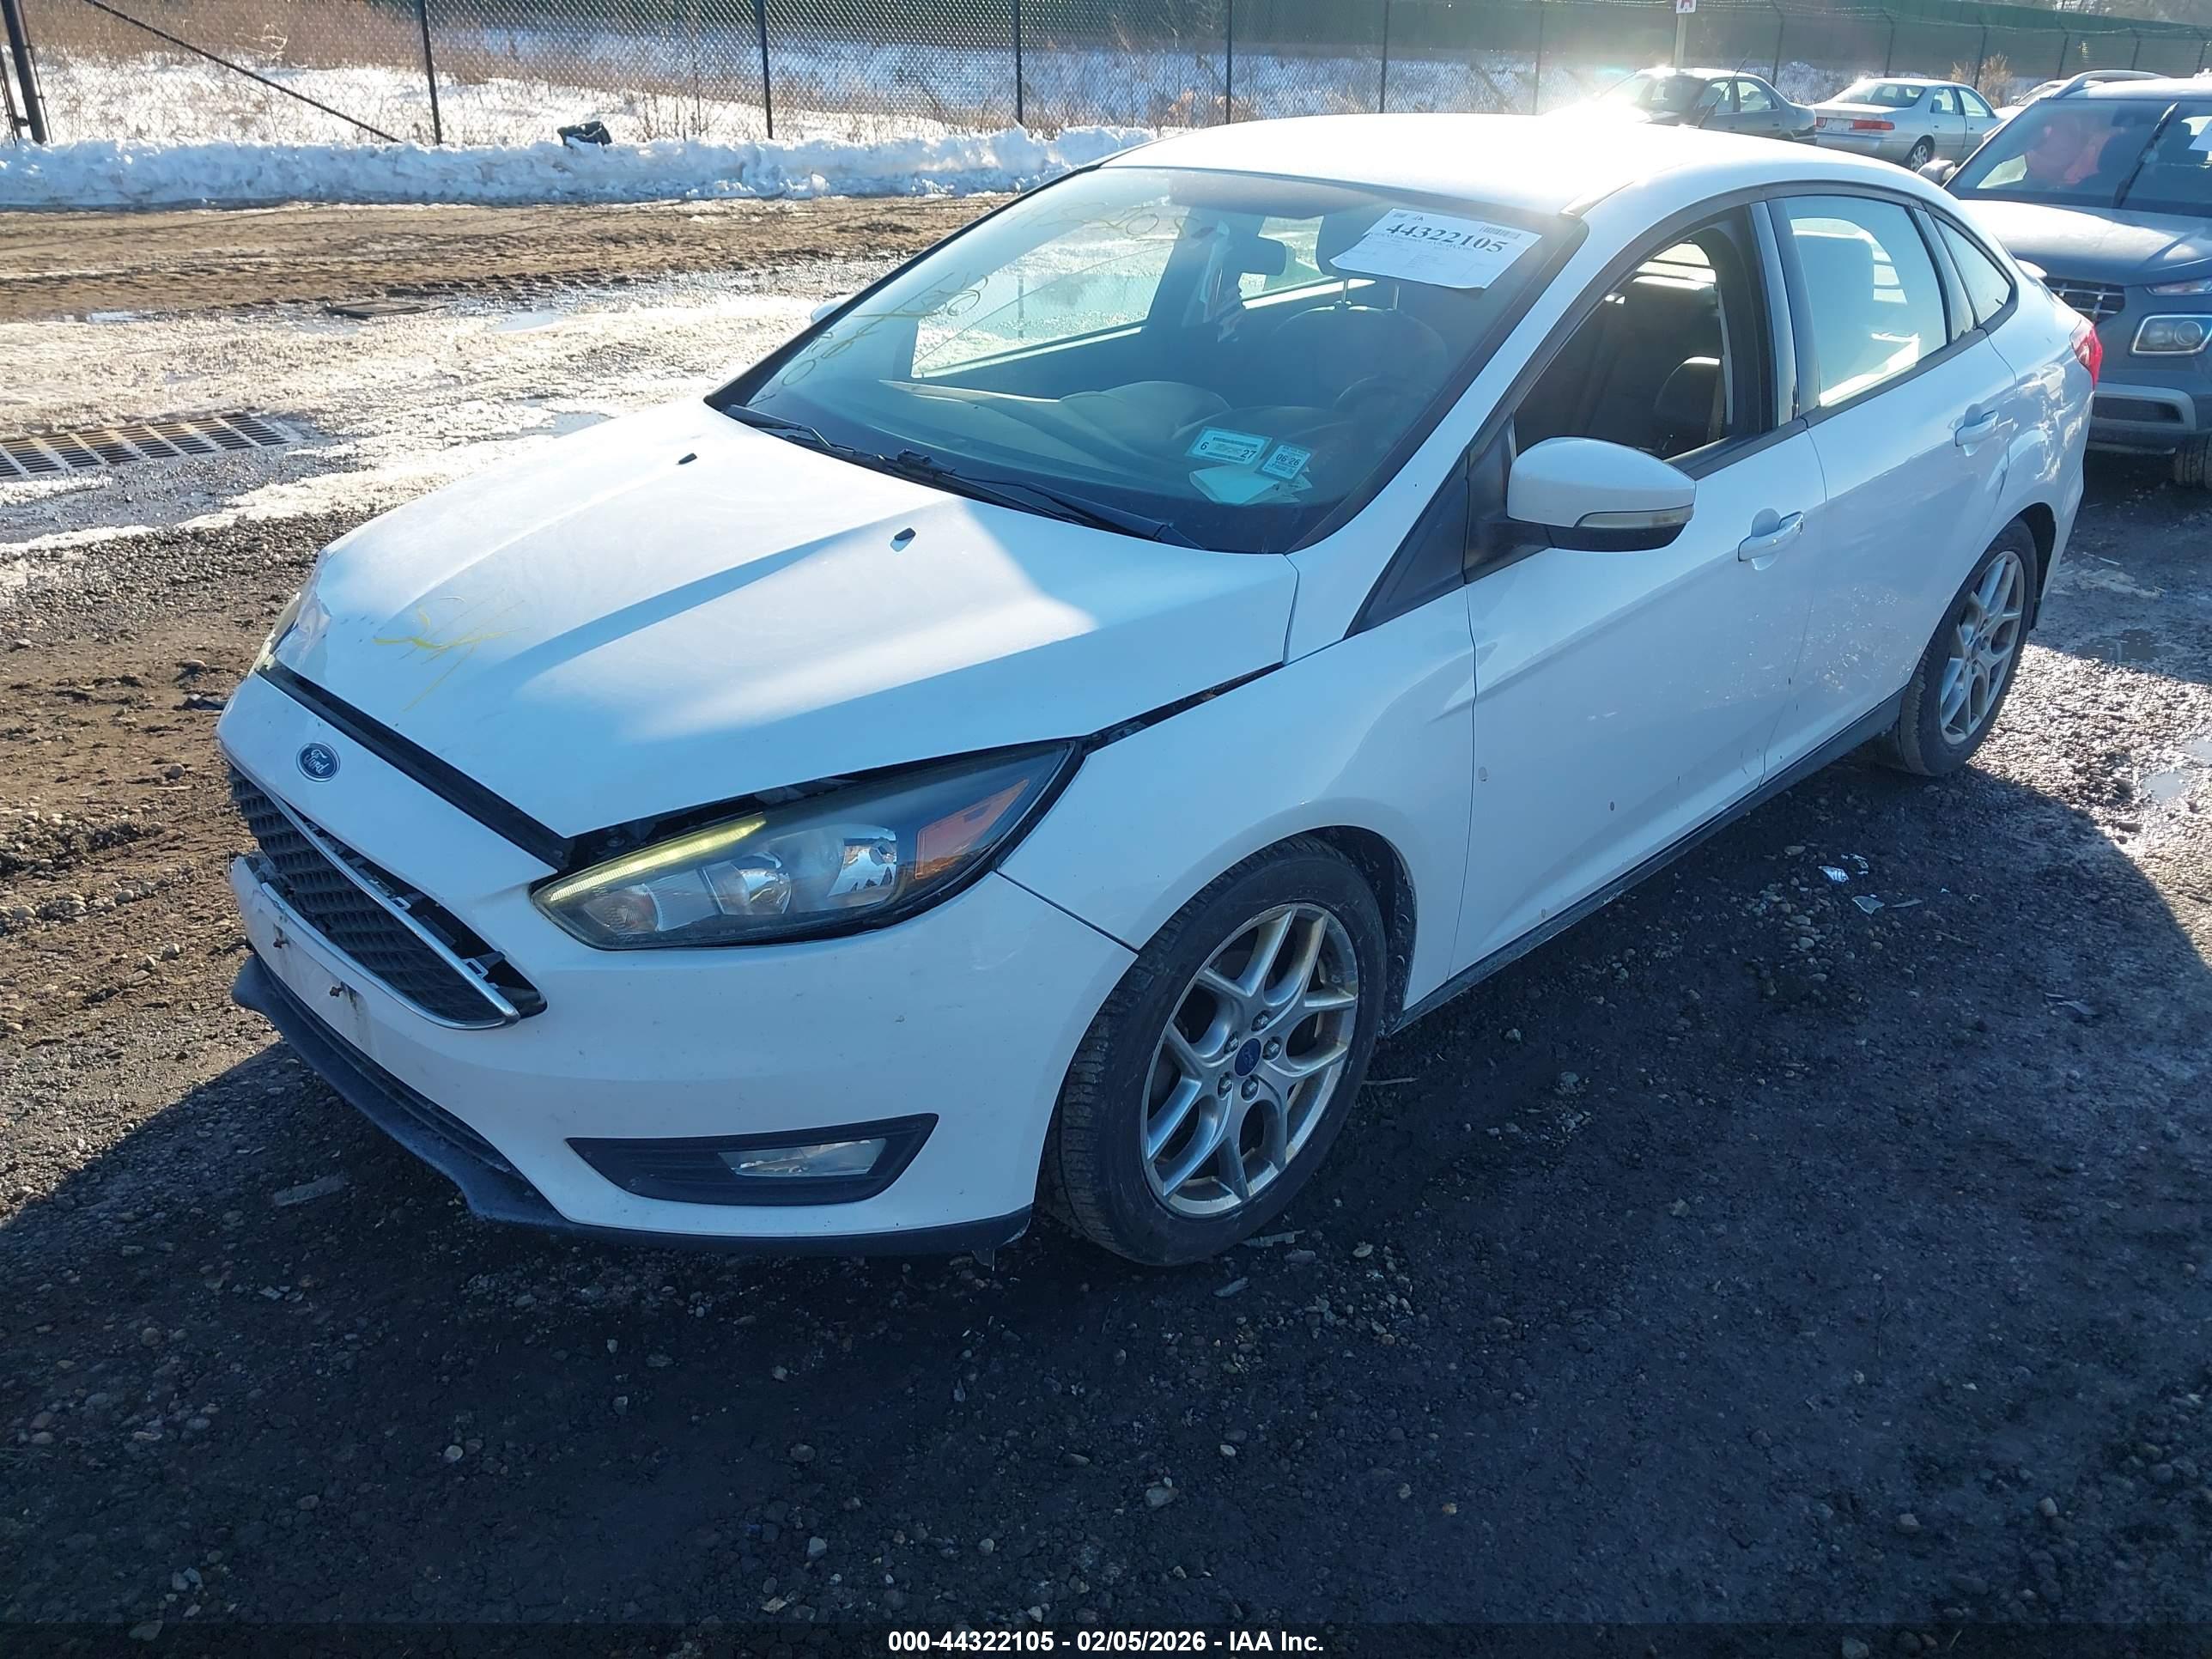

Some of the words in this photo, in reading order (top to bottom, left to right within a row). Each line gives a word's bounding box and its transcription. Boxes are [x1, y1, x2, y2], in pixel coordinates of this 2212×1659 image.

[1385, 222, 1510, 253] 44322105
[1200, 441, 1209, 451] 6
[1240, 449, 1257, 459] 27
[1276, 453, 1289, 462] 06
[1288, 457, 1301, 466] 26
[303, 749, 331, 775] Ford
